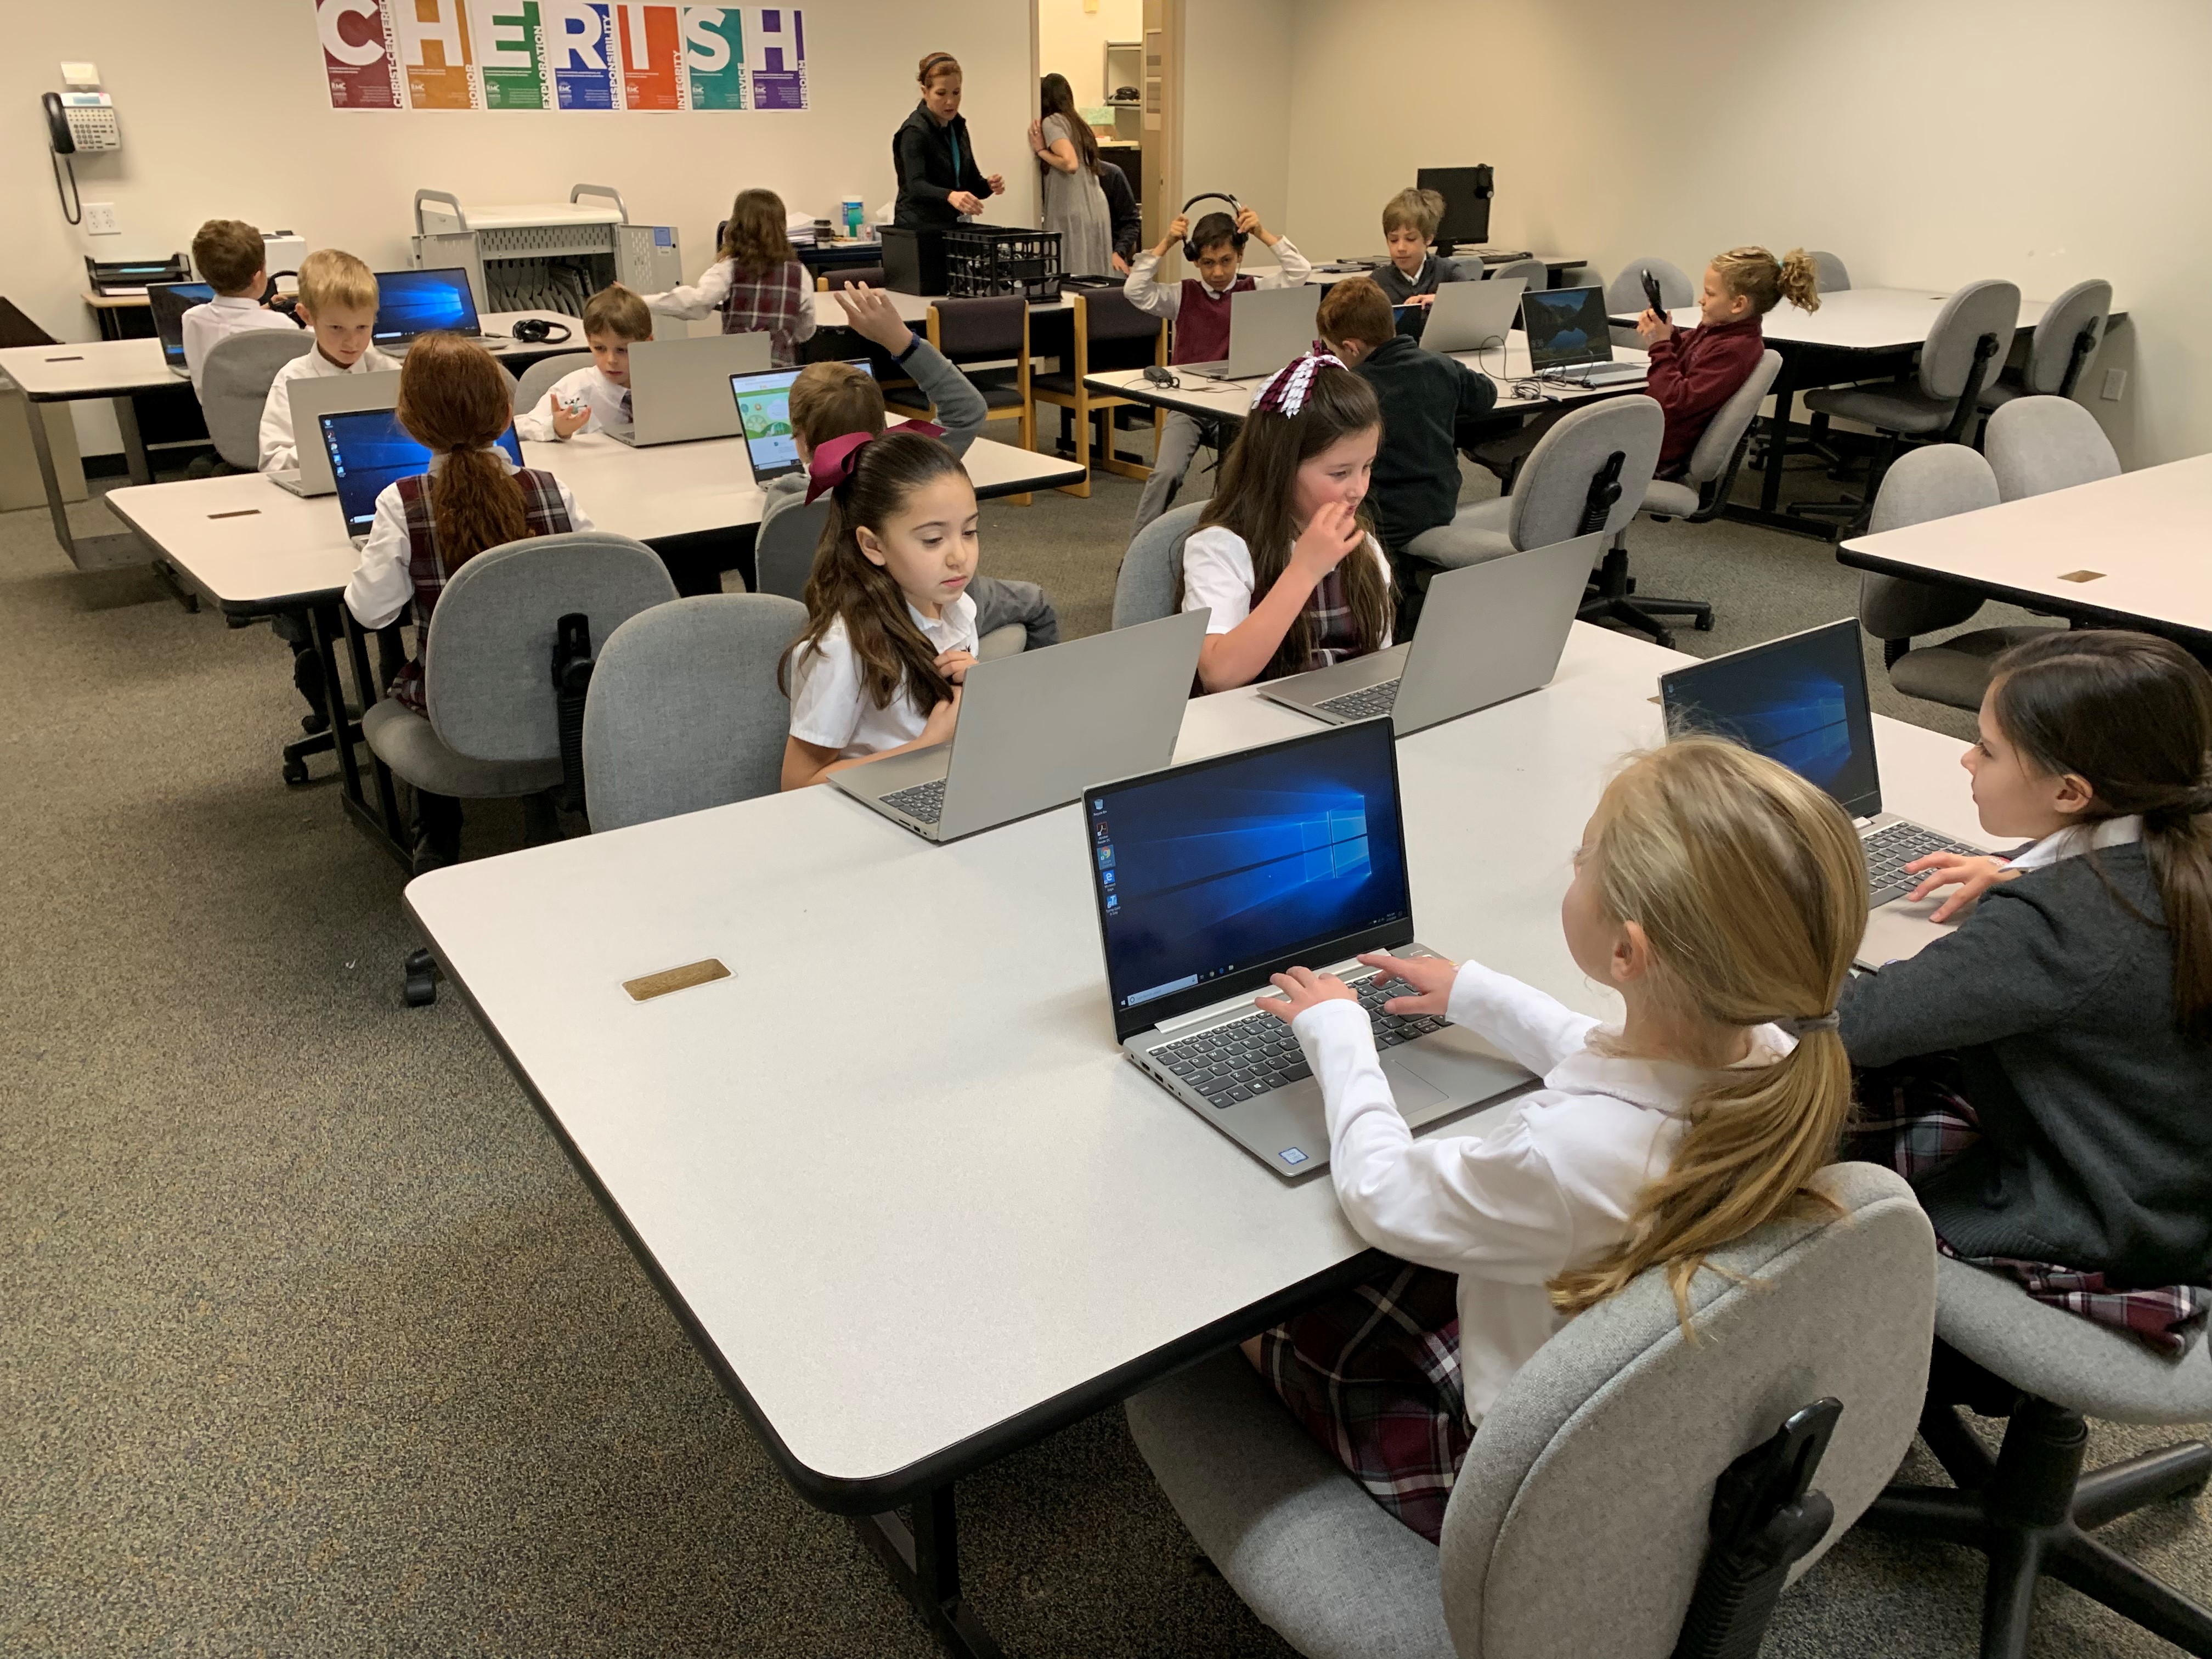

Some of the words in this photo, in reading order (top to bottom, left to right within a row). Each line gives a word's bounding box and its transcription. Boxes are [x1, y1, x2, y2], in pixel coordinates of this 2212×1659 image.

[318, 0, 798, 71] CHERISH
[602, 14, 619, 110] RESPONSIBILITY
[465, 64, 478, 109] HONOR
[533, 25, 550, 109] EXPLORATION
[673, 50, 685, 110] INTEGRITY
[737, 63, 748, 109] SERVICE
[798, 60, 808, 109] HEROISM
